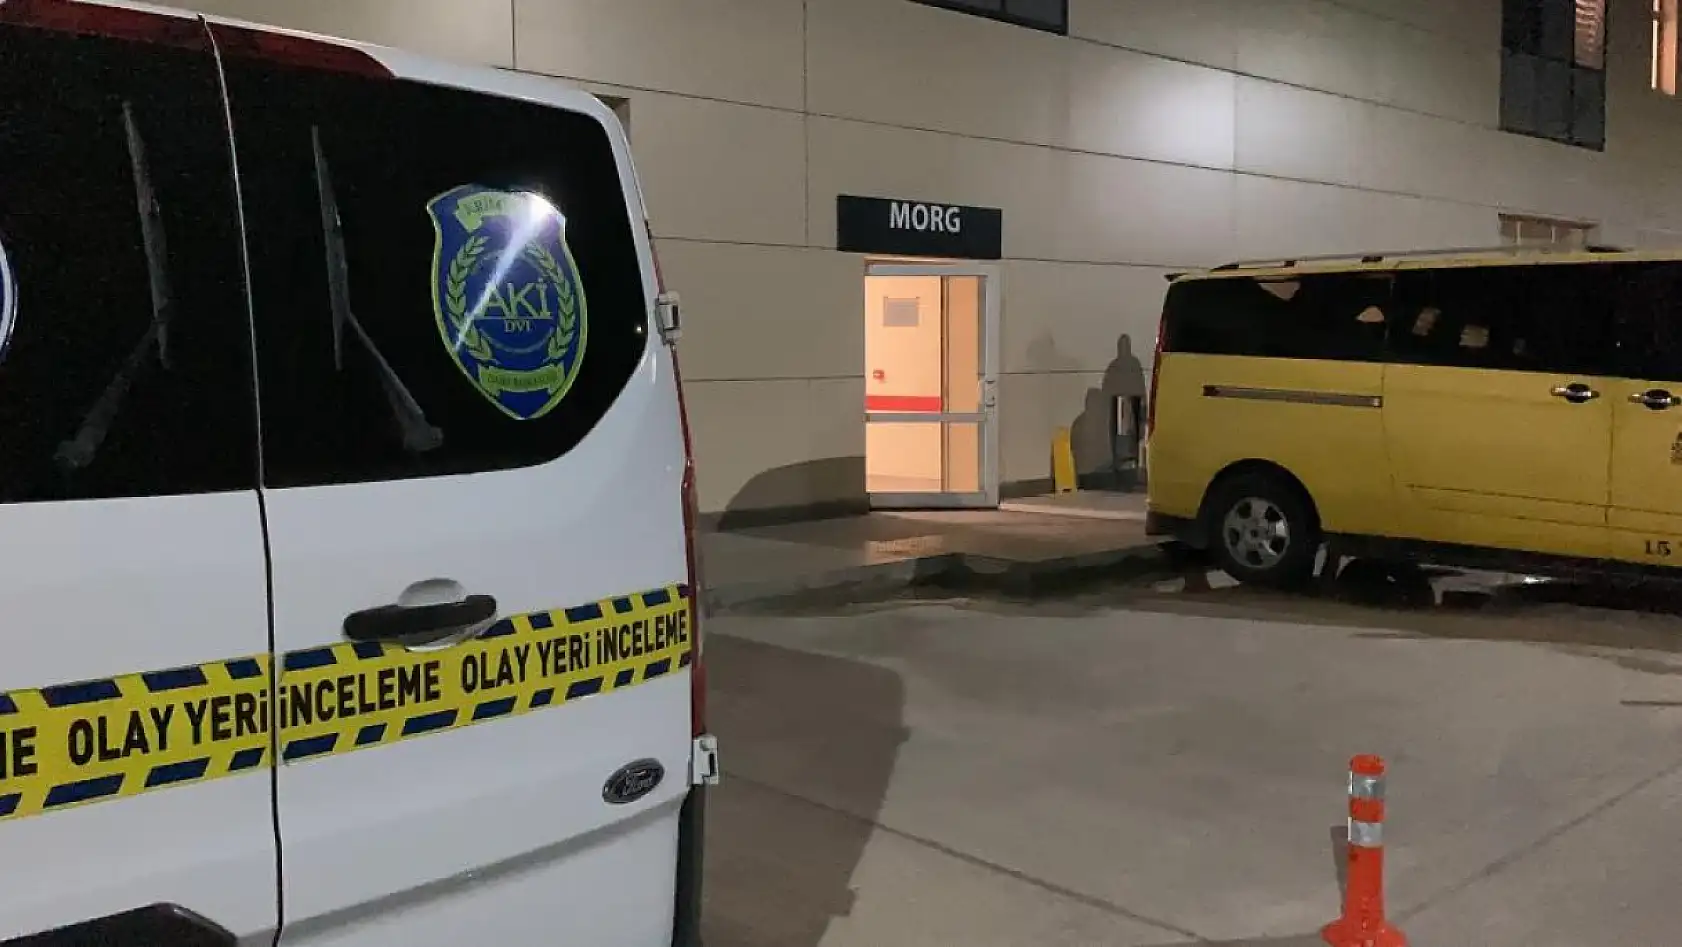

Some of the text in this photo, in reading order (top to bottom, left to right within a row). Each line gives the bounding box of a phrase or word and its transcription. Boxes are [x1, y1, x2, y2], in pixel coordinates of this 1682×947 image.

[889, 201, 961, 233] MORG
[67, 704, 174, 766] OLAY
[461, 643, 530, 694] OLAY
